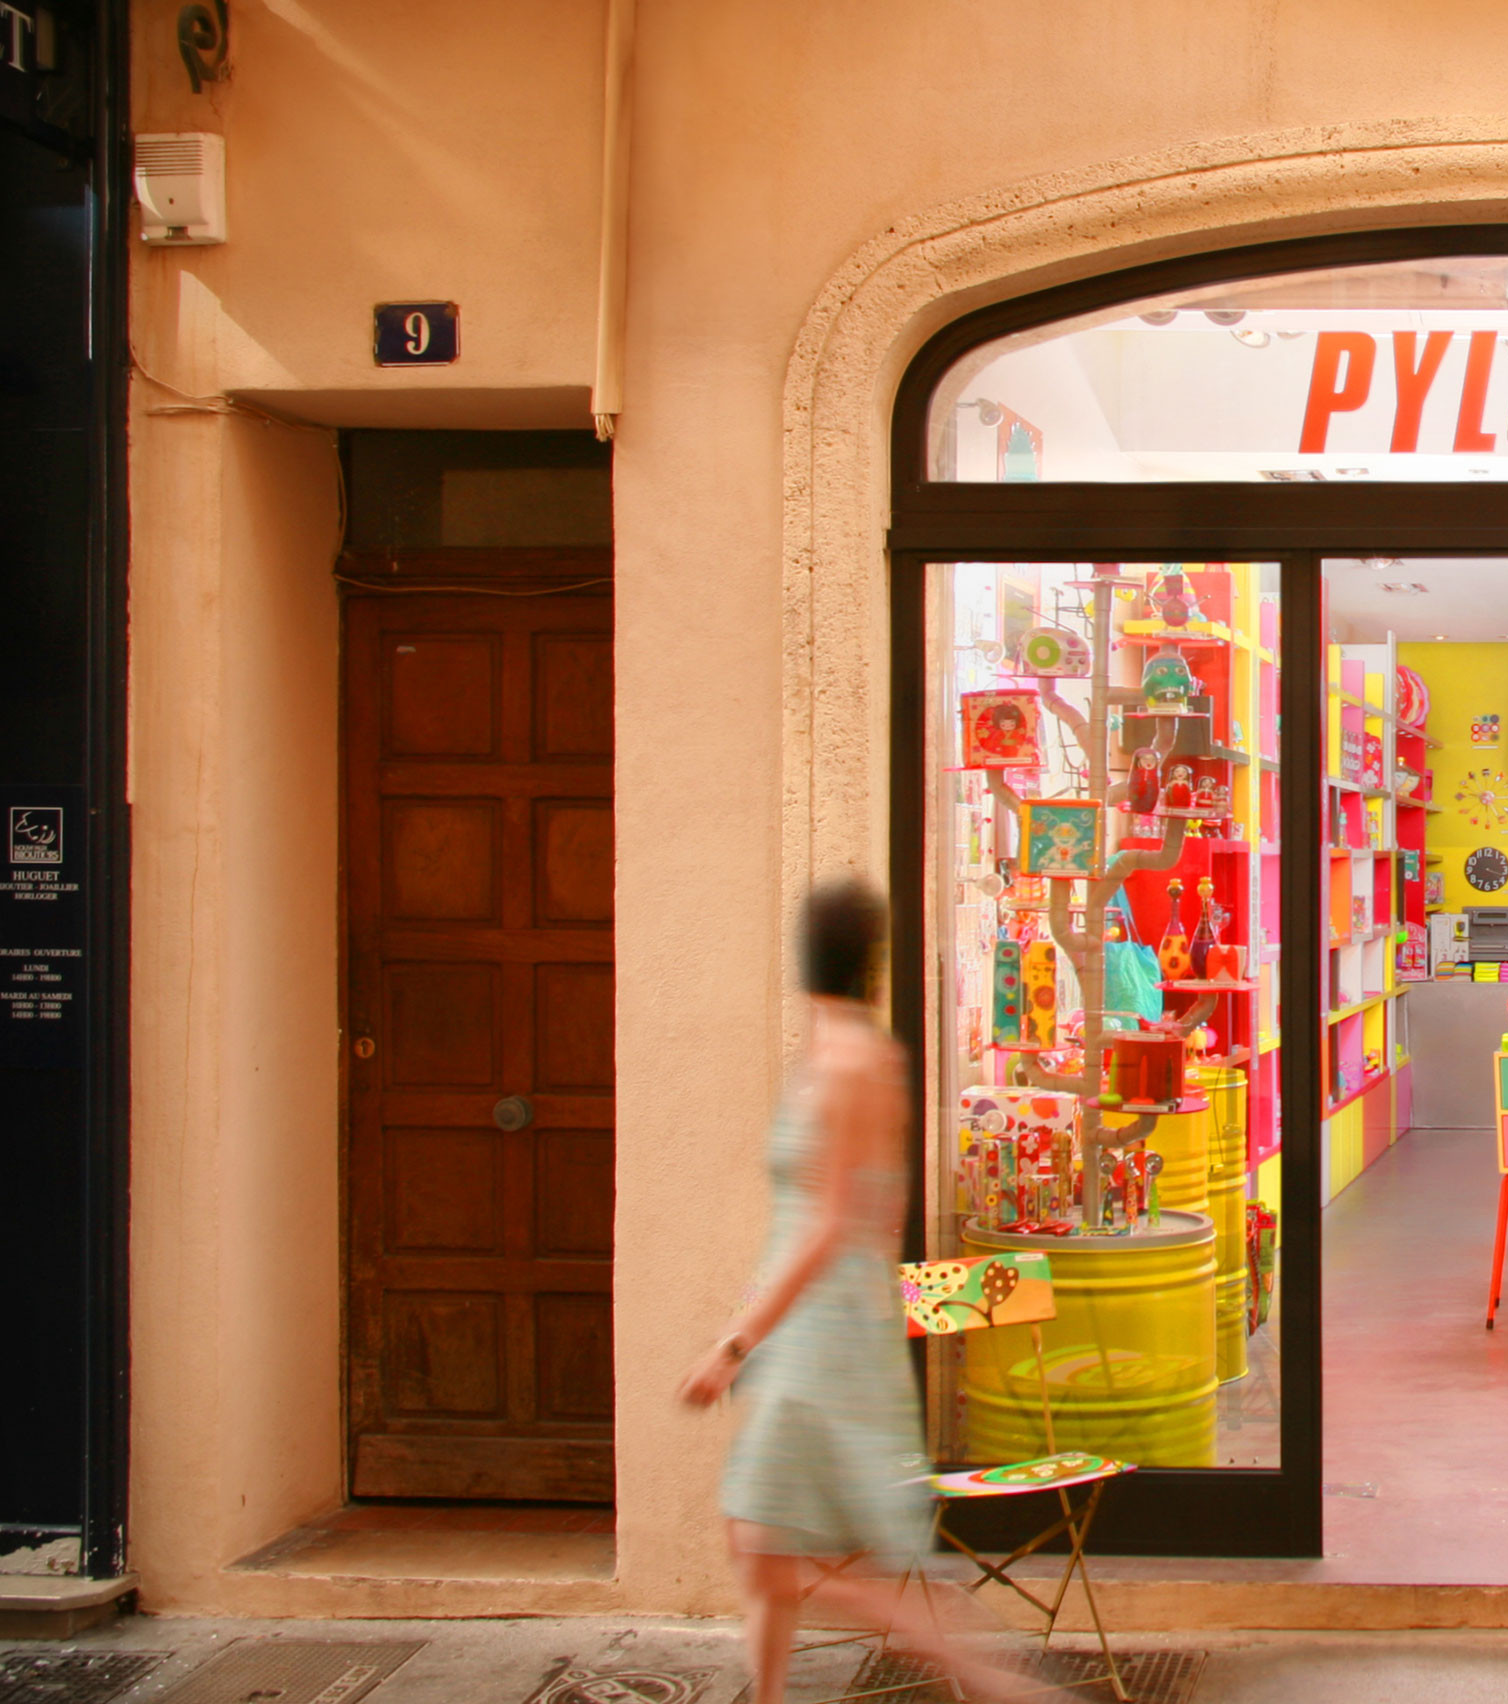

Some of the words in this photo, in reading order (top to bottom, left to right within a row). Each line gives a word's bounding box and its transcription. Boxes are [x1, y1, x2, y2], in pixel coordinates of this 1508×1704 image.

[404, 311, 431, 356] 9
[13, 870, 60, 881] HUGUET
[39, 883, 79, 891] JOAILLIER
[14, 892, 58, 900] HORLOGER
[0, 948, 31, 957] RAIRES
[33, 949, 82, 957] OUVERTURE
[23, 964, 49, 972] LUNDI
[1, 992, 27, 1000] MARDI
[28, 992, 40, 1000] AU
